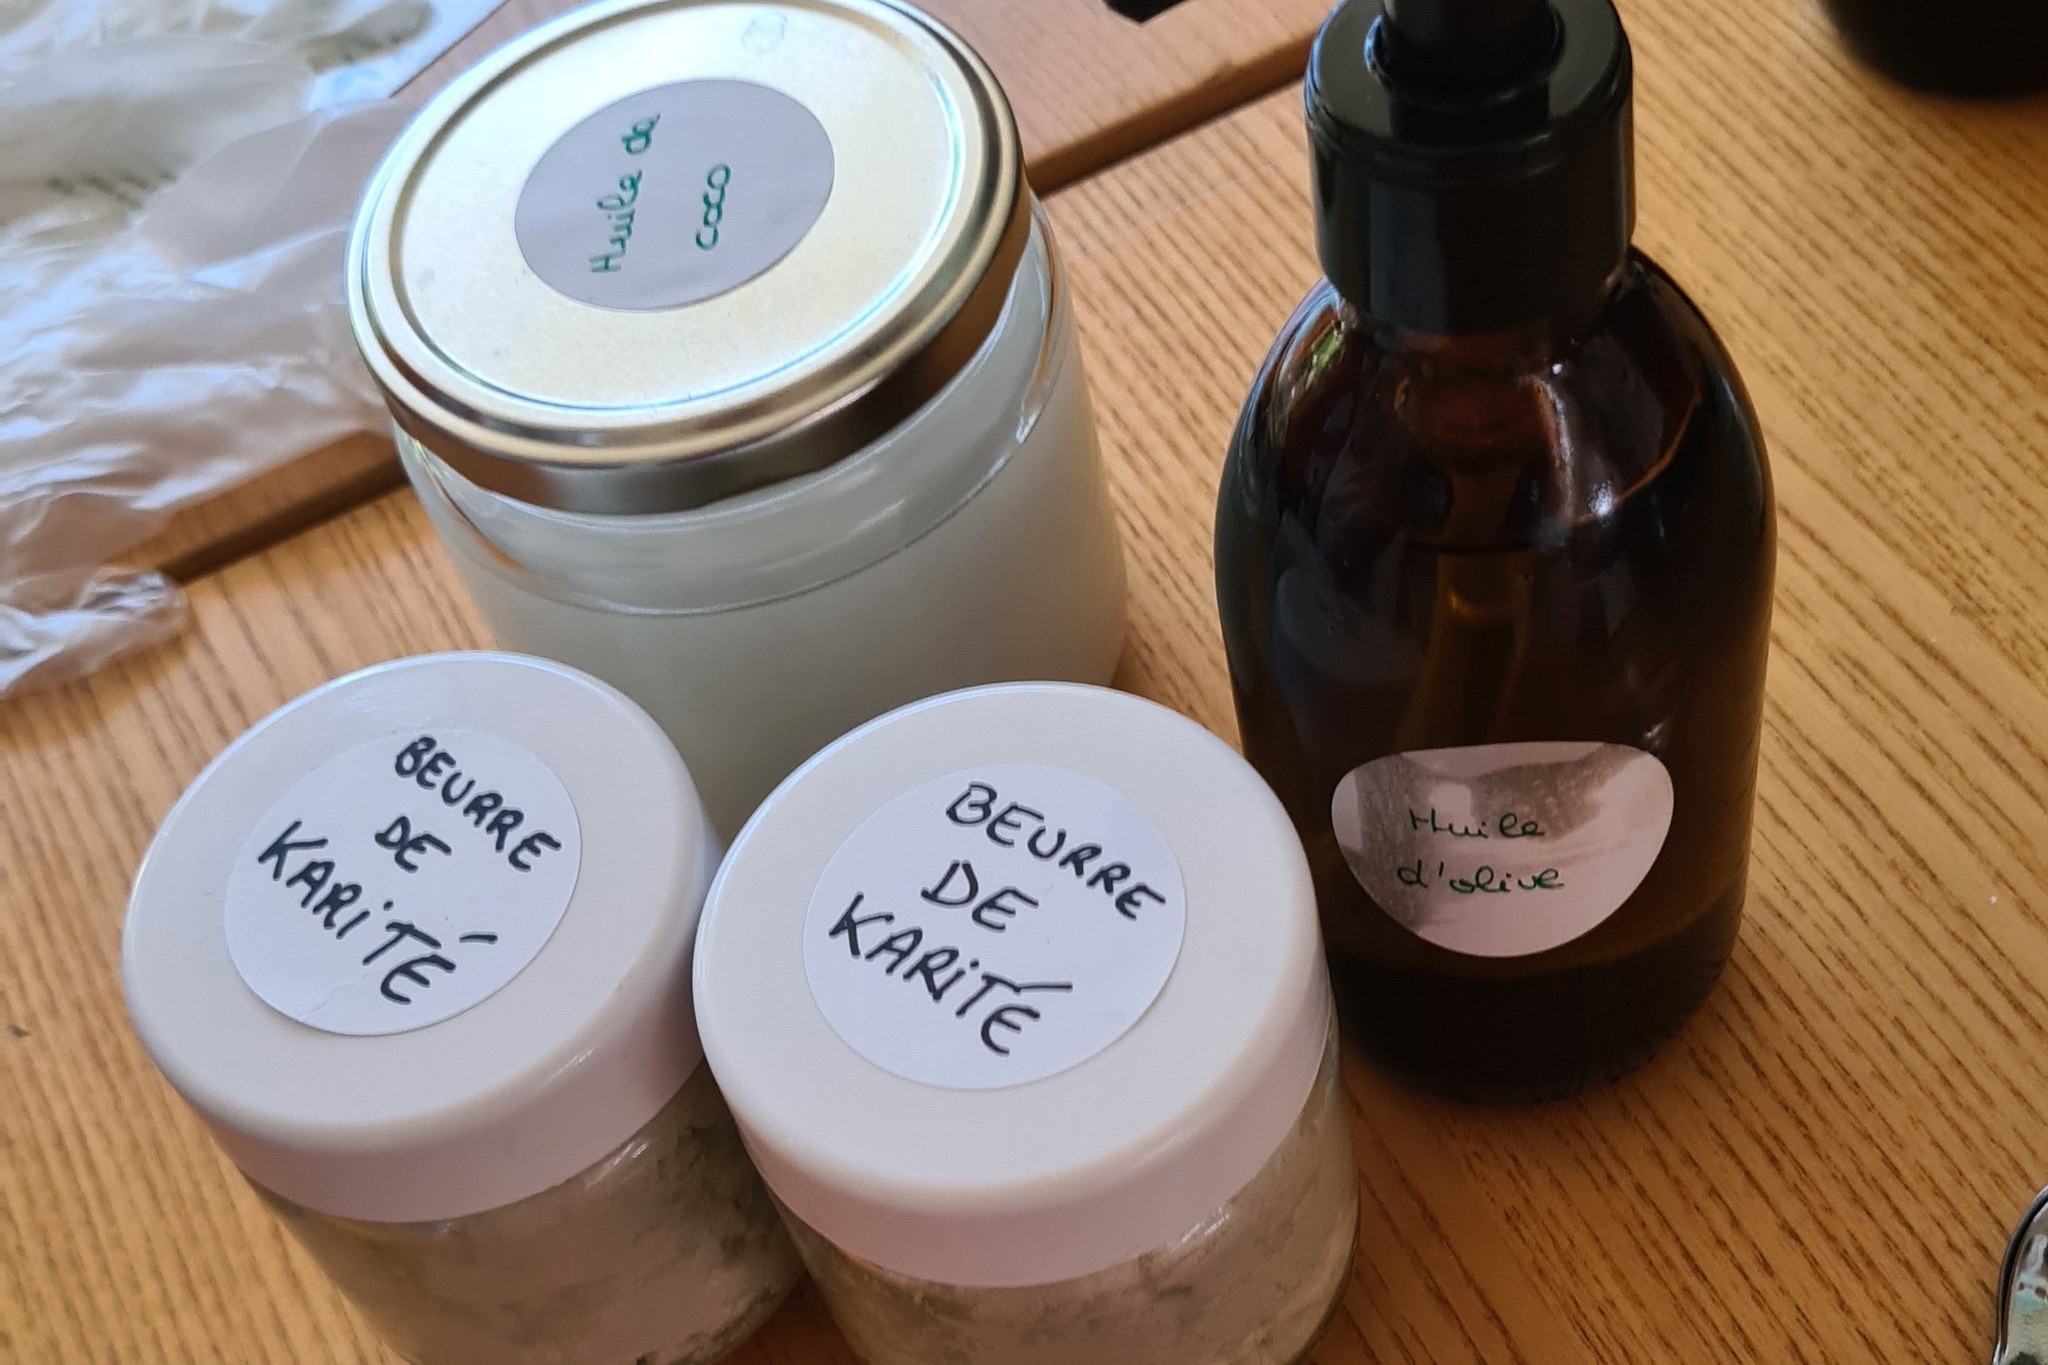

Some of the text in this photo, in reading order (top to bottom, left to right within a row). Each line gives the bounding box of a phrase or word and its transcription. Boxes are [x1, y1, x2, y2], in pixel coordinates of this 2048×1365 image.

[589, 113, 661, 273] Huile de
[394, 735, 562, 872] BEURRE
[1407, 807, 1545, 840] Huile
[374, 814, 452, 873] DE
[945, 781, 1167, 921] BEURRE
[1396, 859, 1565, 894] d'olive
[920, 859, 1040, 933] DE
